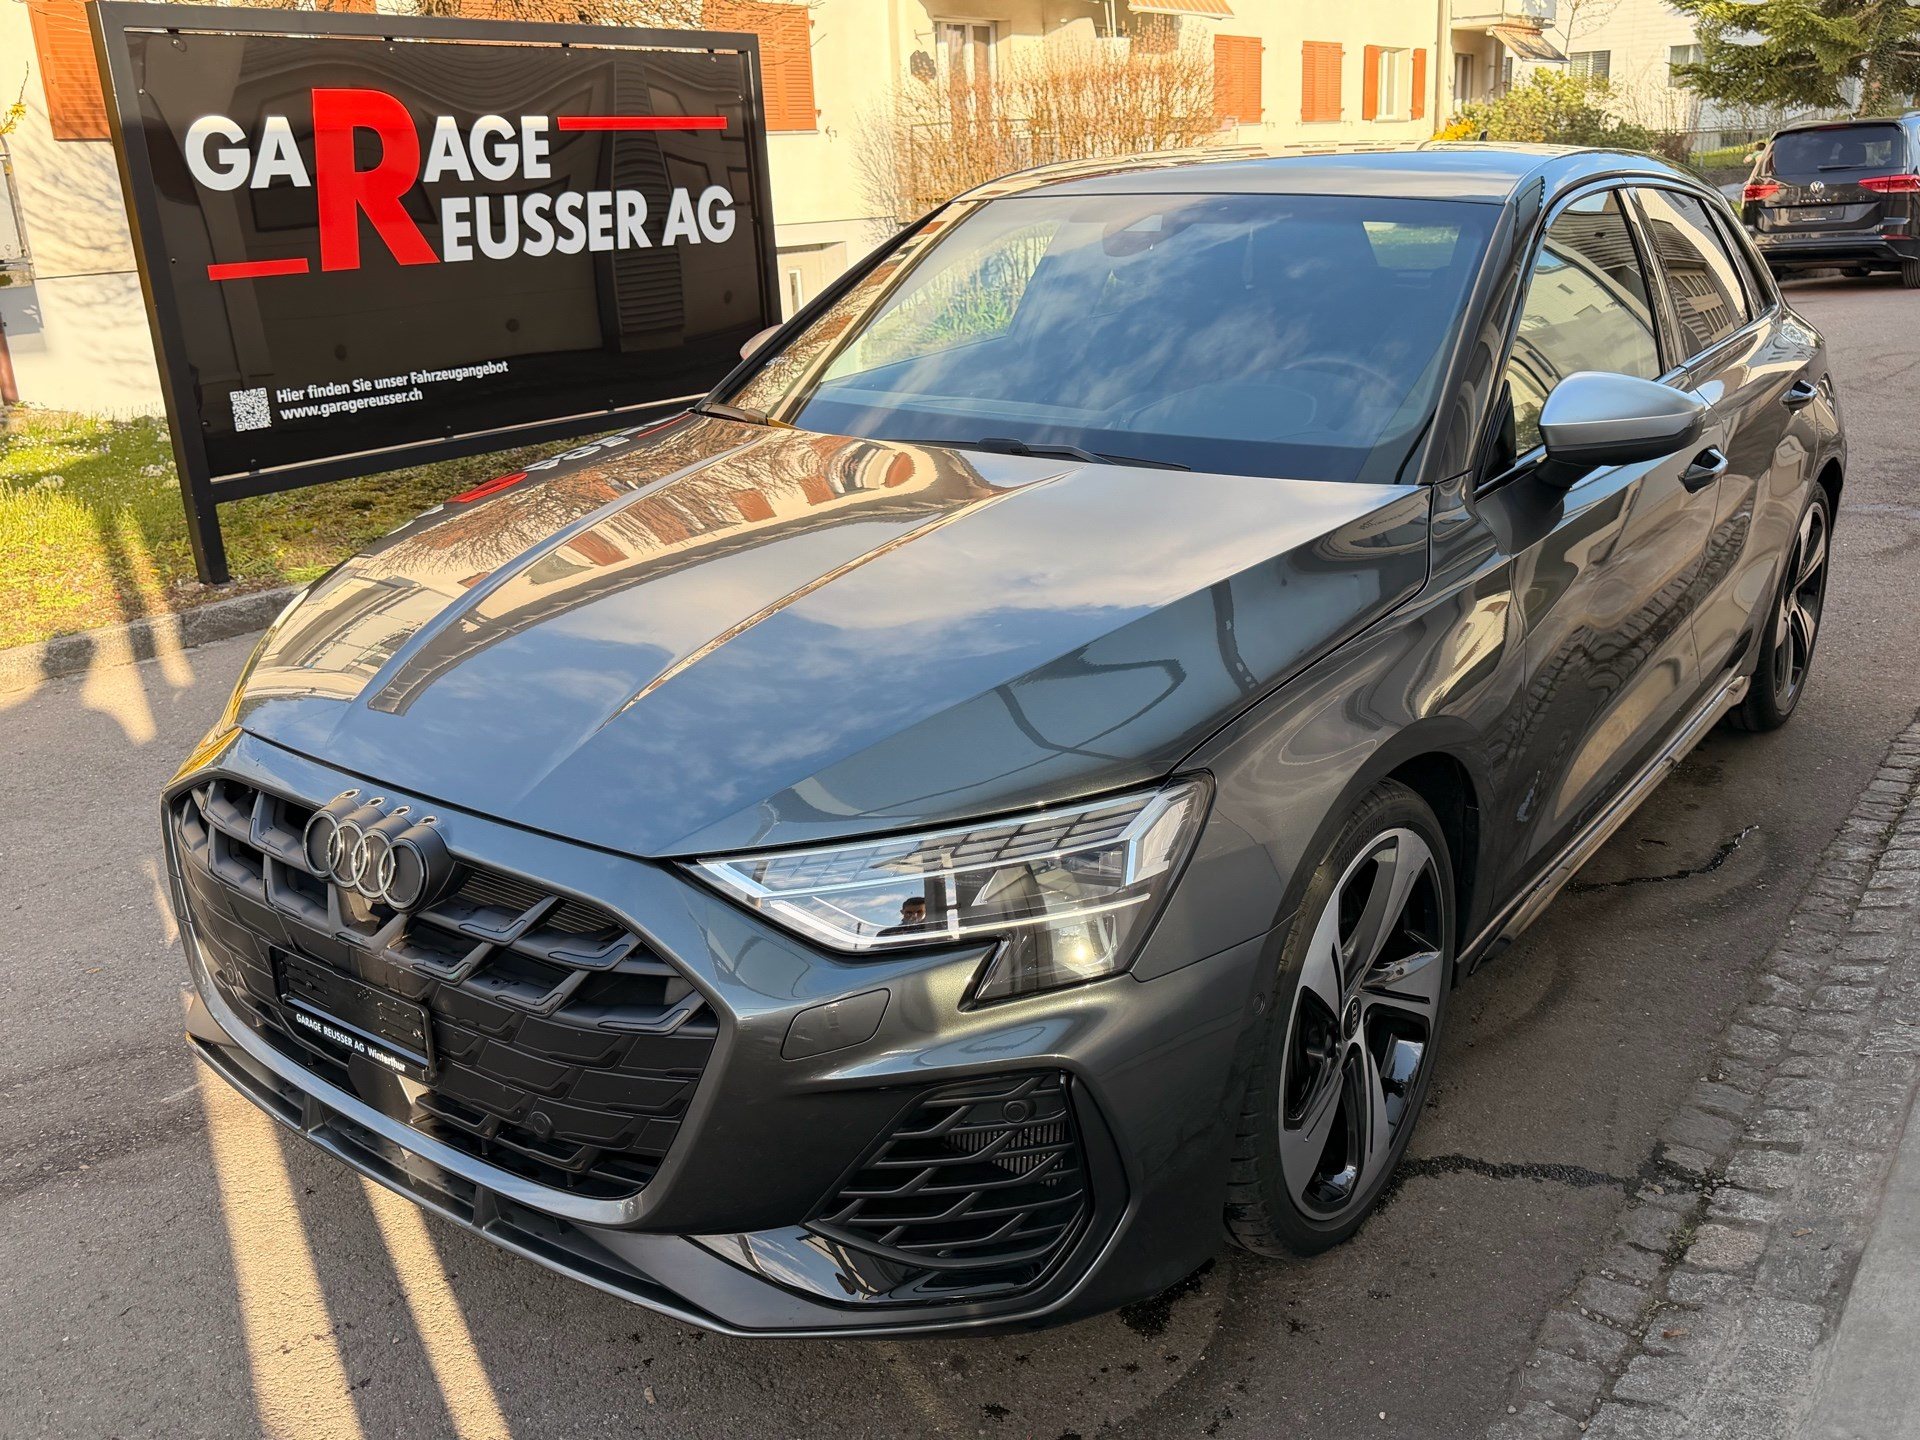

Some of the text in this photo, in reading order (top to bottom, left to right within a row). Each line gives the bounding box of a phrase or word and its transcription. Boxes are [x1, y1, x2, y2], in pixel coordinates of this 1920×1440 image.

[185, 88, 551, 271] GARAGE
[661, 185, 736, 247] AG
[276, 360, 509, 404] Hier finden Sie unser Fahrzeugangebot
[280, 387, 423, 420] www.garagereusser.ch
[296, 1013, 406, 1072] GARAGE REUSSER AG Winterthur
